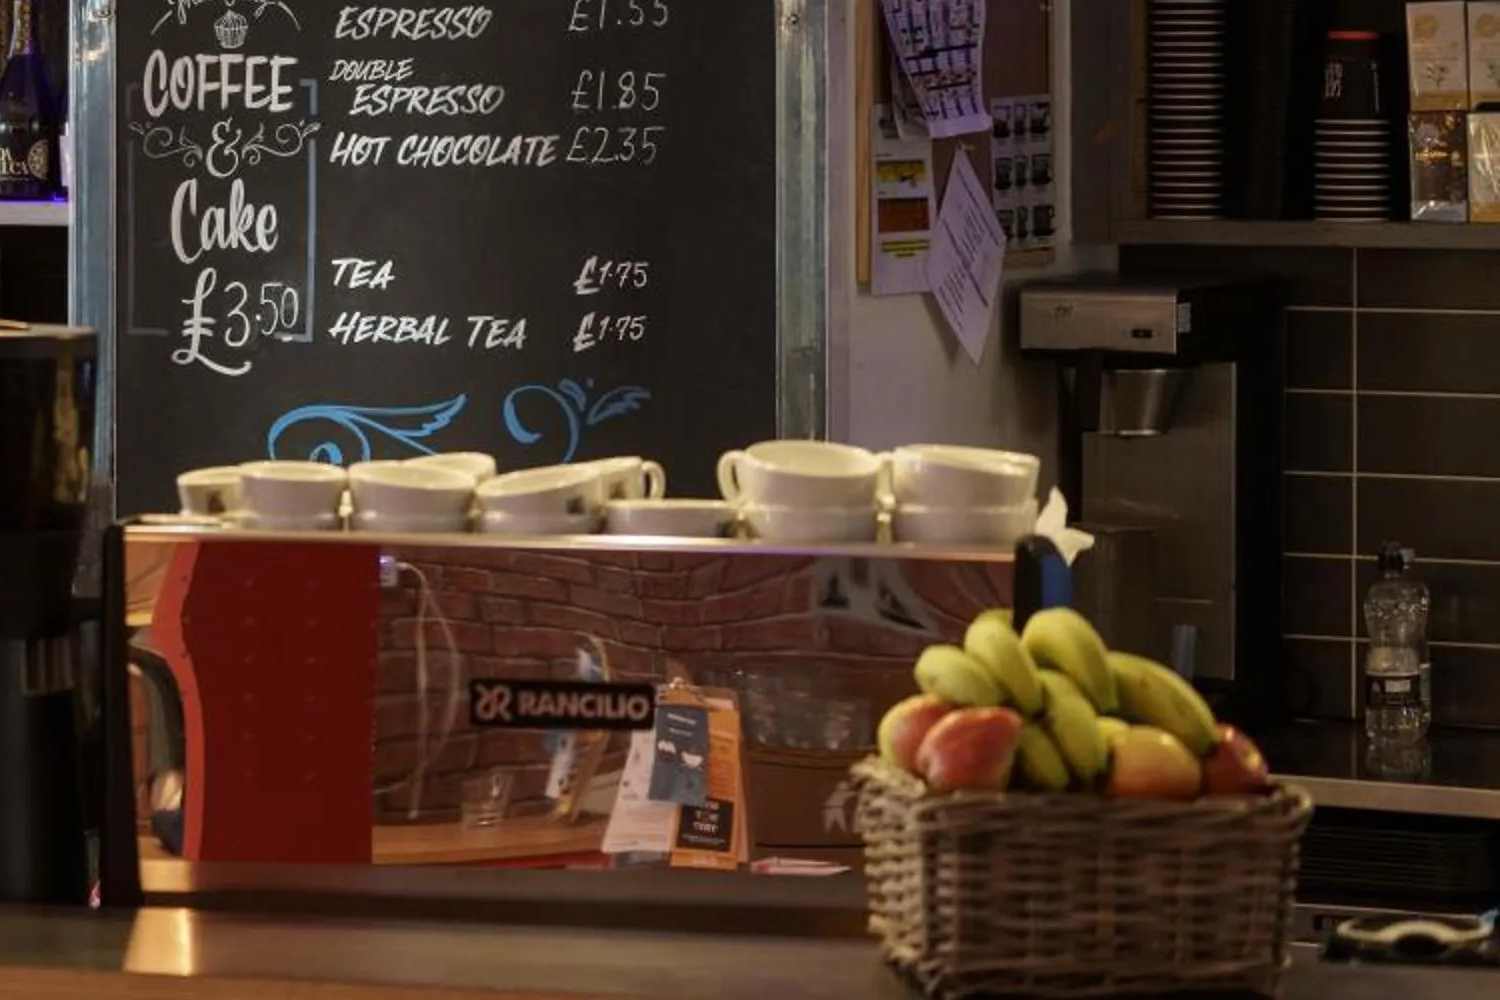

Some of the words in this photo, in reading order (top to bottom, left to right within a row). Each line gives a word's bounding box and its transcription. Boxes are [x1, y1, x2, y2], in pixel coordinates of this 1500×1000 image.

[334, 8, 493, 40] ESPRESSO
[143, 49, 299, 116] COFFEE
[329, 58, 414, 83] DOUBLE
[350, 83, 505, 116] ESPRESSO
[570, 71, 667, 112] £1.85
[204, 117, 240, 178] &
[329, 133, 388, 166] HOT
[396, 134, 560, 168] CHOCOLATE
[565, 127, 667, 165] £2.35
[170, 180, 278, 265] Cake
[330, 258, 396, 289] TEA
[172, 268, 300, 375] £3.50
[328, 312, 451, 345] HERBAL
[466, 316, 527, 348] TEA
[516, 690, 650, 721] RANCILIO
